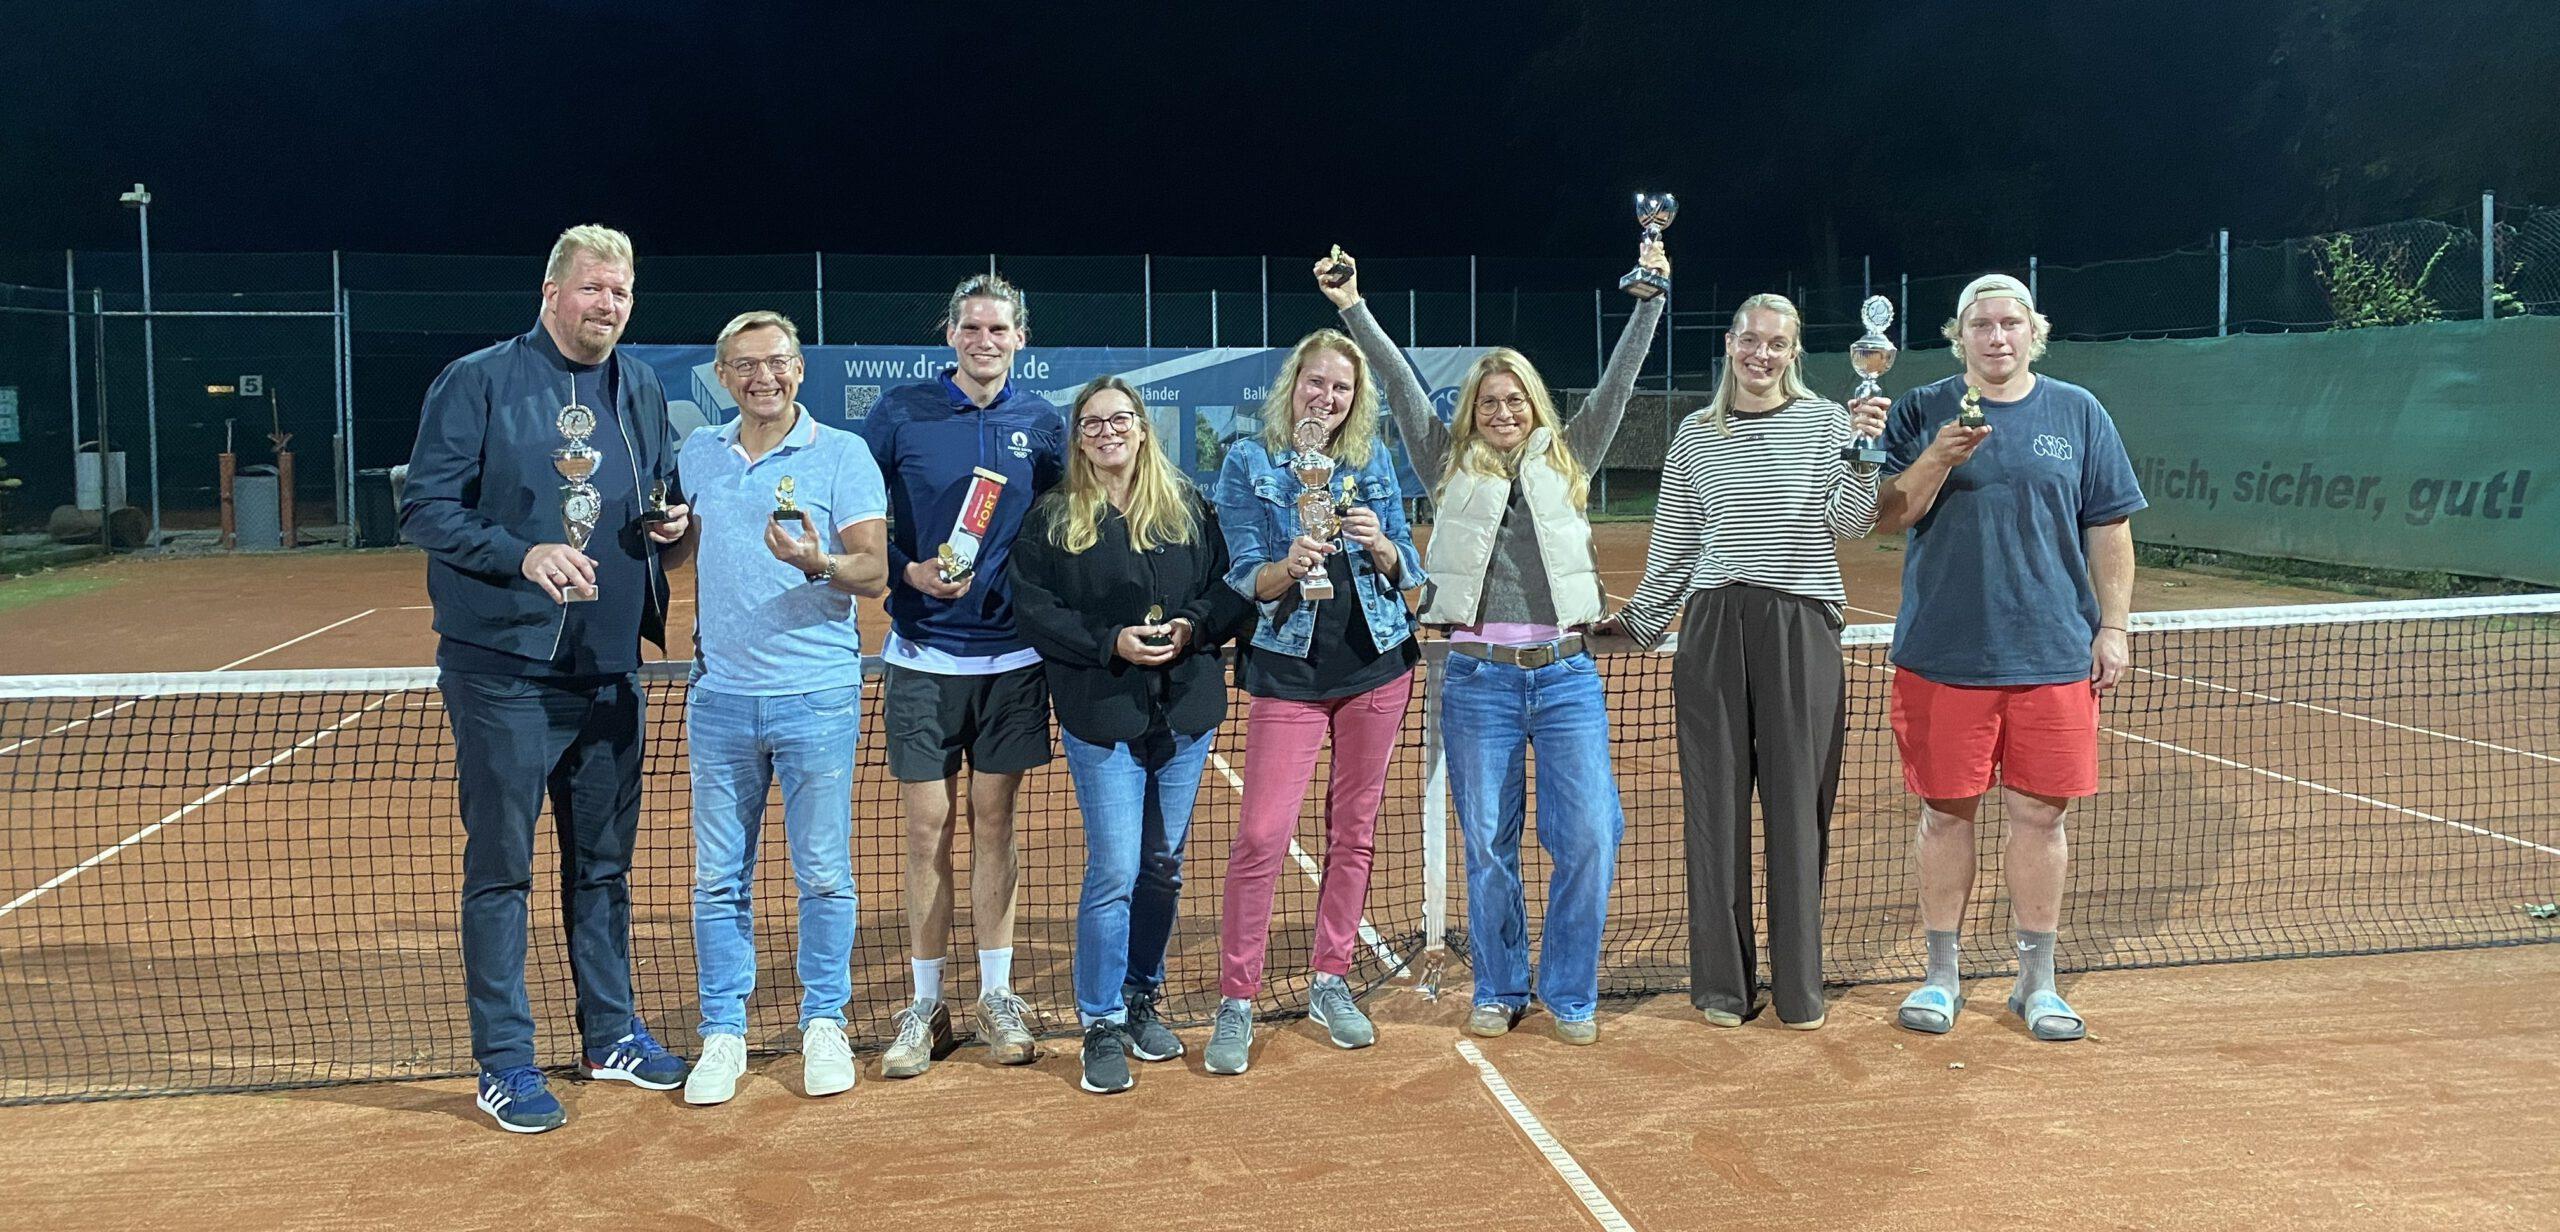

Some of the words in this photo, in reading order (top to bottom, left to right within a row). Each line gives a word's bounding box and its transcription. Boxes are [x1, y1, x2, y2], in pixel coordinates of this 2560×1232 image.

[245, 378, 258, 393] 5
[1141, 386, 1180, 401] länder
[1243, 386, 1269, 401] Balk
[2232, 460, 2387, 522] sicher,
[2404, 469, 2532, 526] gut!
[977, 491, 997, 529] FORT
